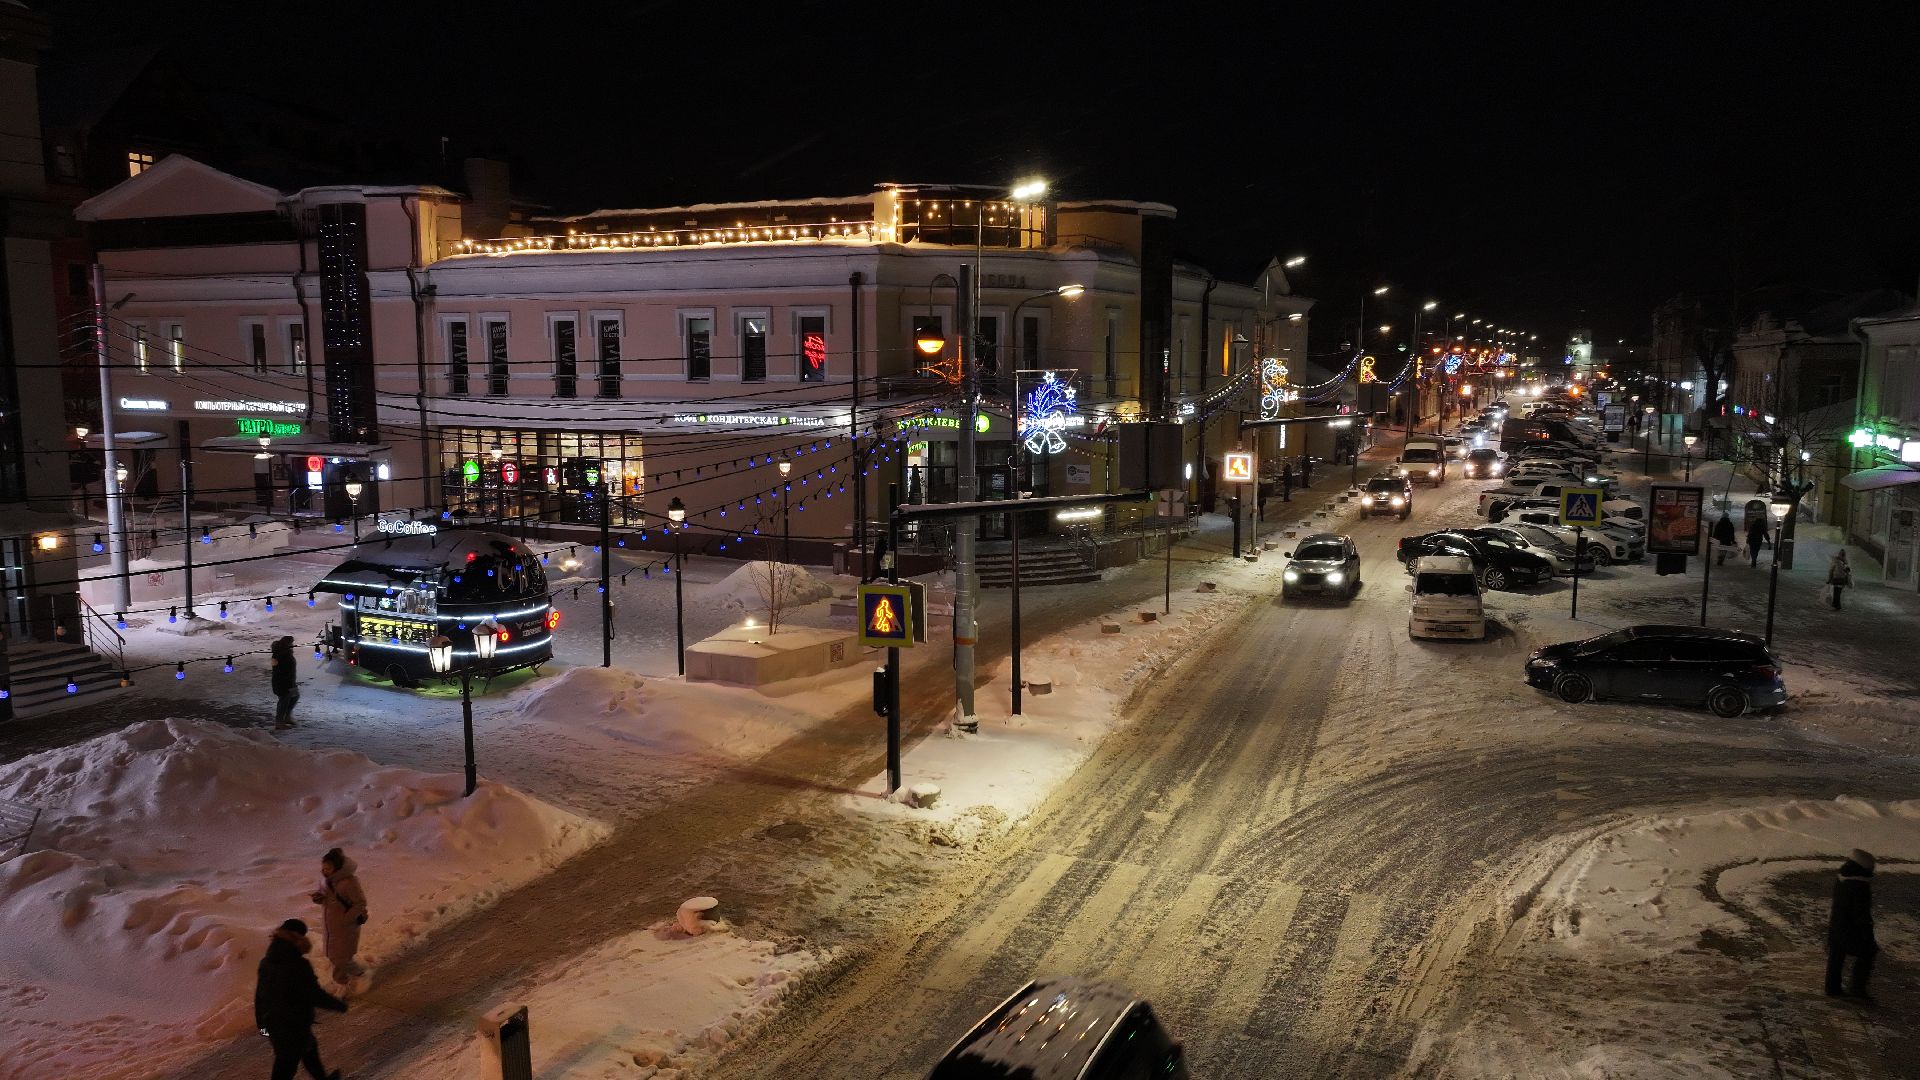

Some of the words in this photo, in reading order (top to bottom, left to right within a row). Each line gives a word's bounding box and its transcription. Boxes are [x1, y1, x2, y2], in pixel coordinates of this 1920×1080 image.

[707, 415, 778, 425] КОНДИТЕРСКАЯ
[789, 416, 825, 426] ПИЦЦА
[377, 519, 438, 536] GoCoffee
